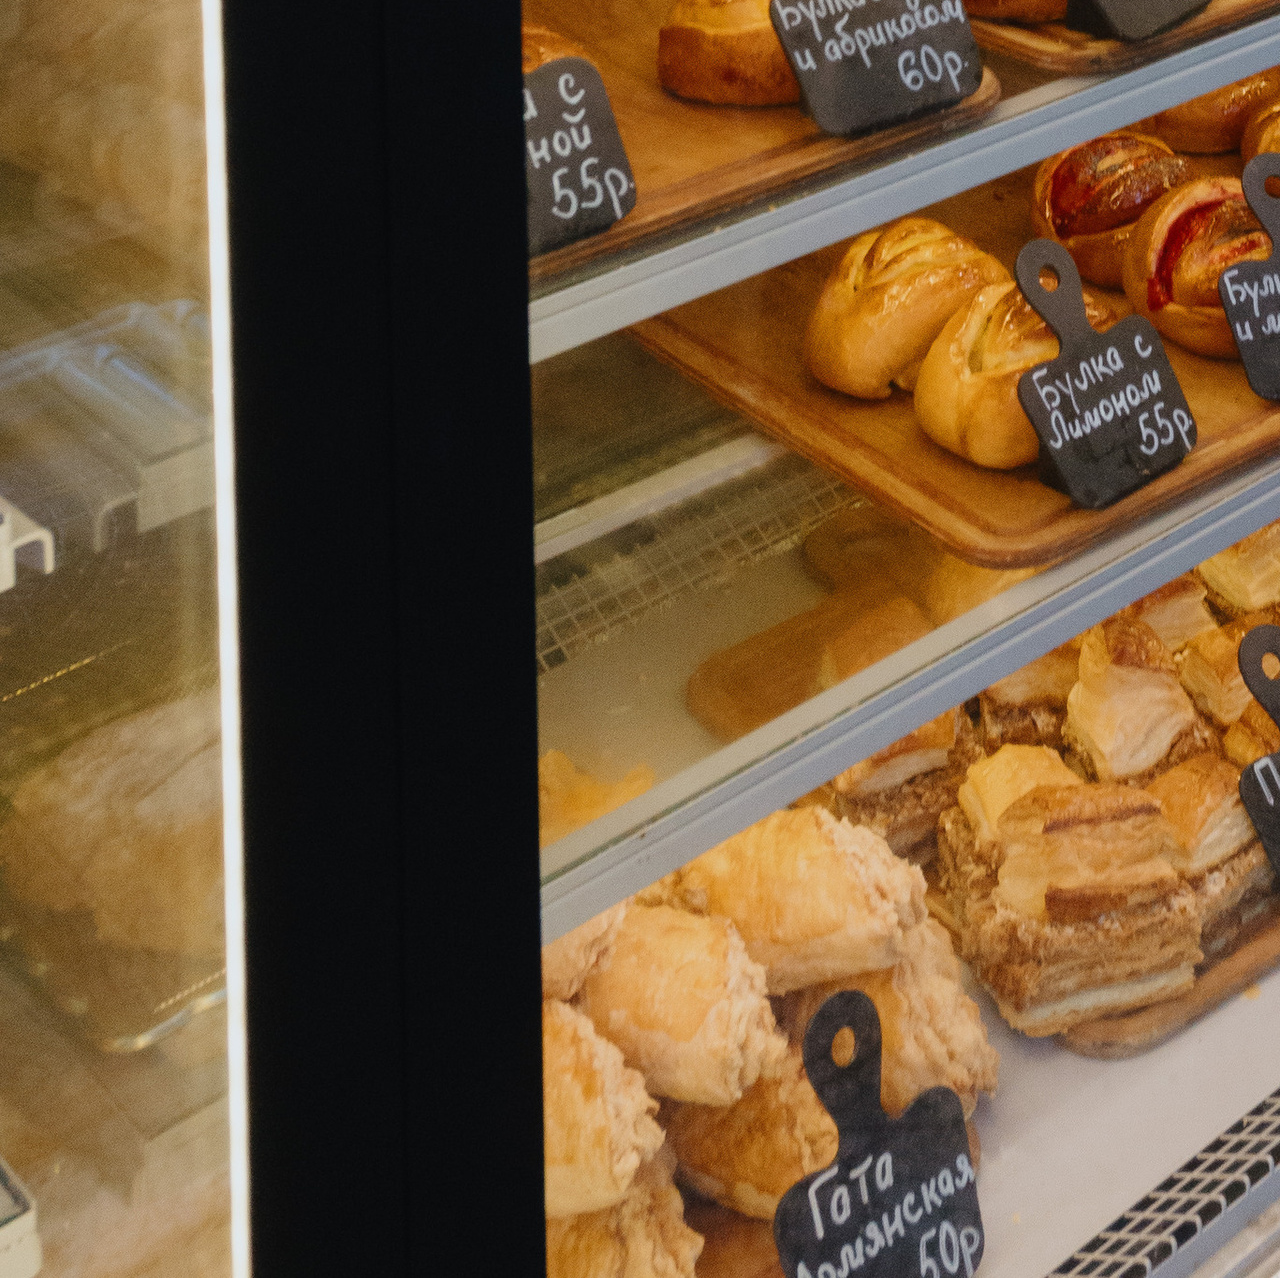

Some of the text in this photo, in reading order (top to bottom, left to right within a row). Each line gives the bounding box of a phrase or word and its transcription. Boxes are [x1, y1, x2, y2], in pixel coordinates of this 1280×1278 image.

[794, 49, 817, 71] и
[558, 73, 586, 105] с
[1235, 320, 1254, 342] и
[1032, 335, 1153, 414] Булка с
[1050, 369, 1162, 449] Лимоном
[808, 1151, 894, 1240] Гата
